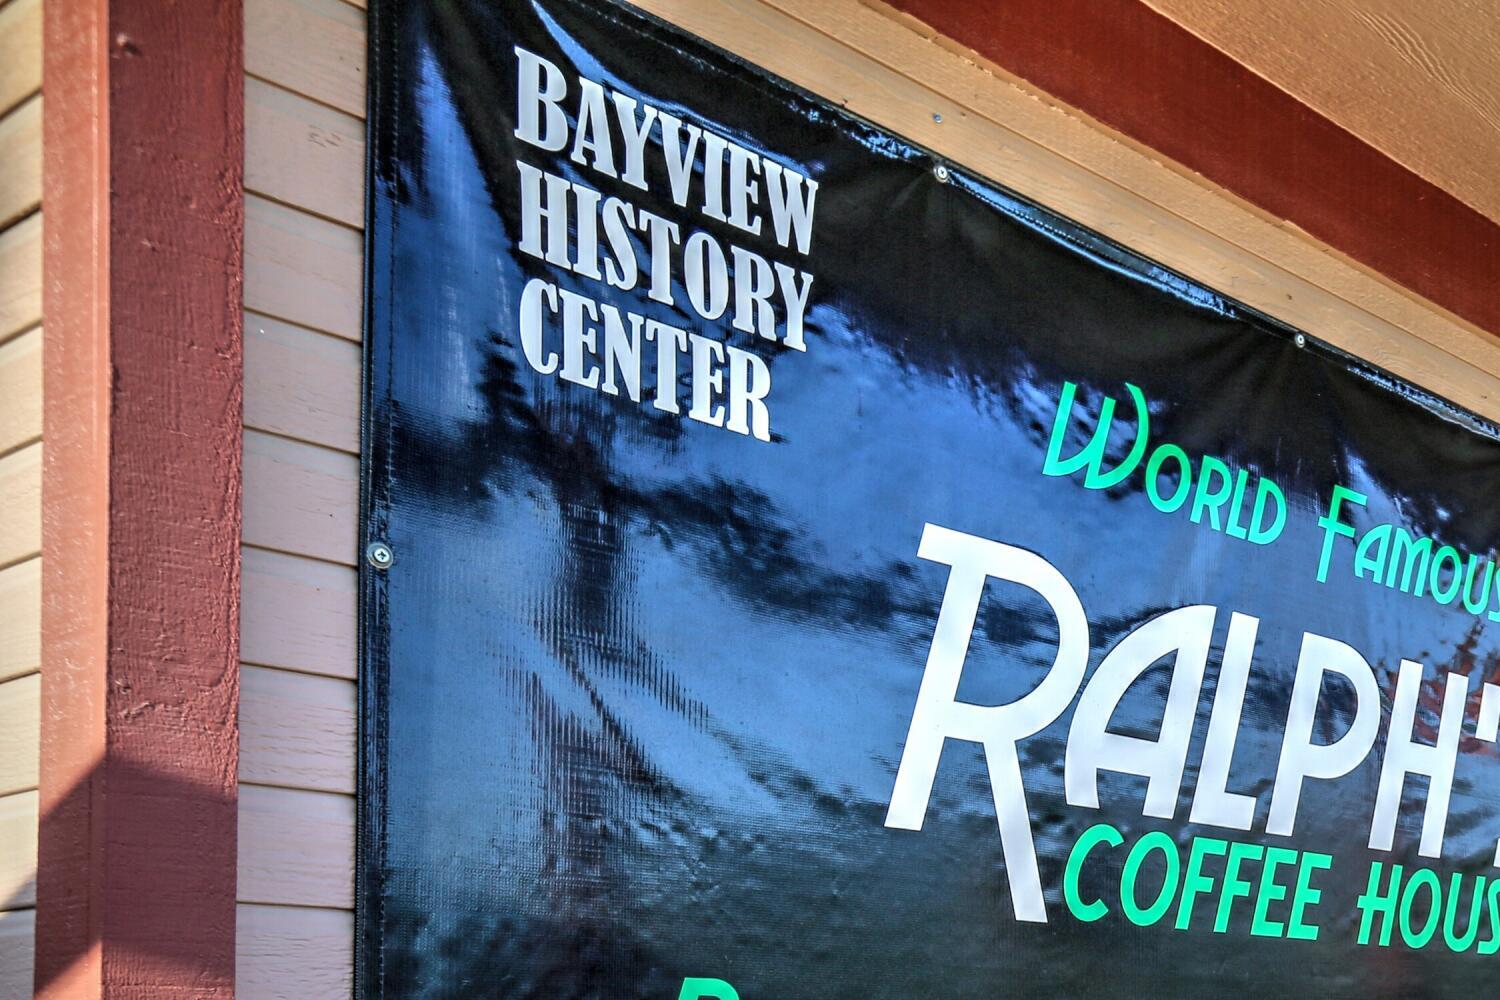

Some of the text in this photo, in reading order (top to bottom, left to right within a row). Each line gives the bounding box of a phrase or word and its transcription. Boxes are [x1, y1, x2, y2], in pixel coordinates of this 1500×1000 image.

[514, 46, 819, 256] BAYVIEW
[516, 160, 814, 353] HISTORY
[519, 278, 772, 443] CENTER
[1042, 381, 1287, 545] WORLD
[1063, 823, 1333, 941] COFFEE
